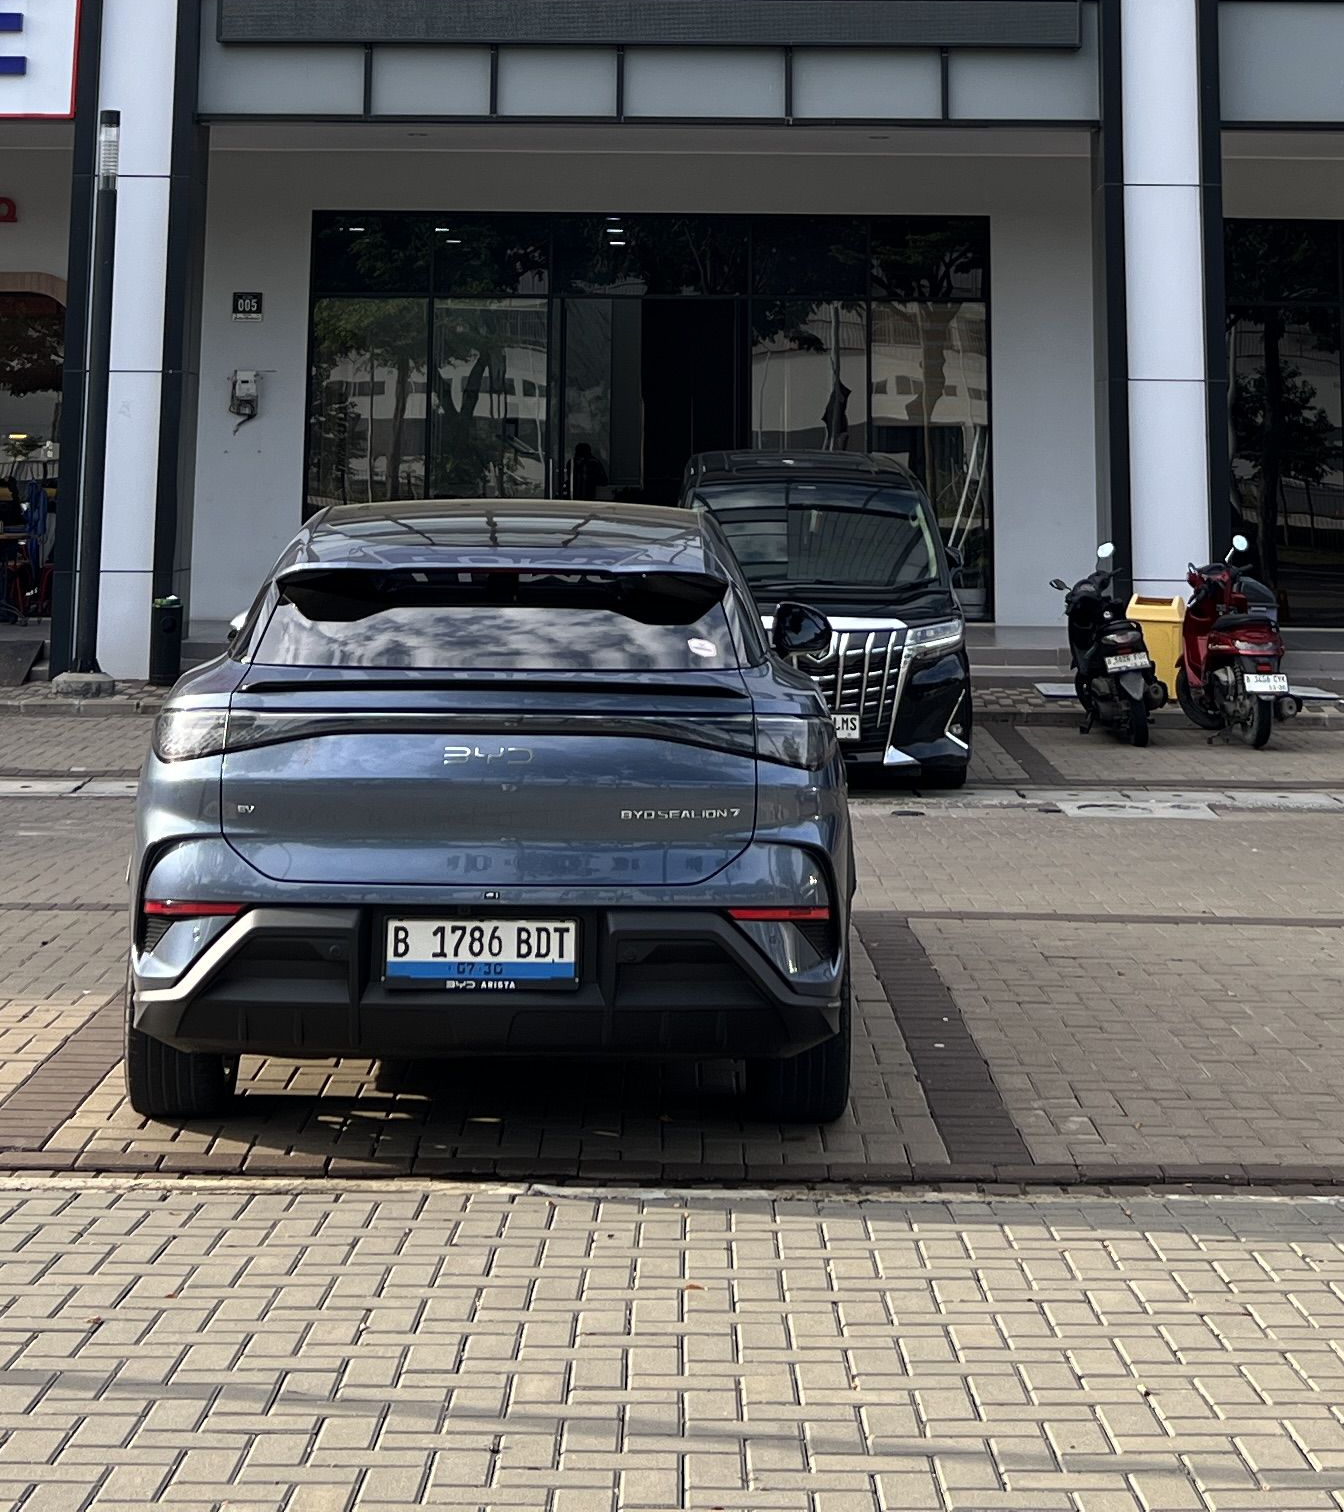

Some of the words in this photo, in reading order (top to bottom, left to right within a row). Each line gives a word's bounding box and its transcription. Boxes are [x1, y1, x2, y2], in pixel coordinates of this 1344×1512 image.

[238, 299, 258, 312] 005
[443, 746, 533, 765] BYD
[621, 809, 655, 819] BYD
[730, 808, 741, 817] 7
[393, 926, 409, 958] B
[432, 925, 503, 958] 1786
[516, 927, 570, 959] BDT
